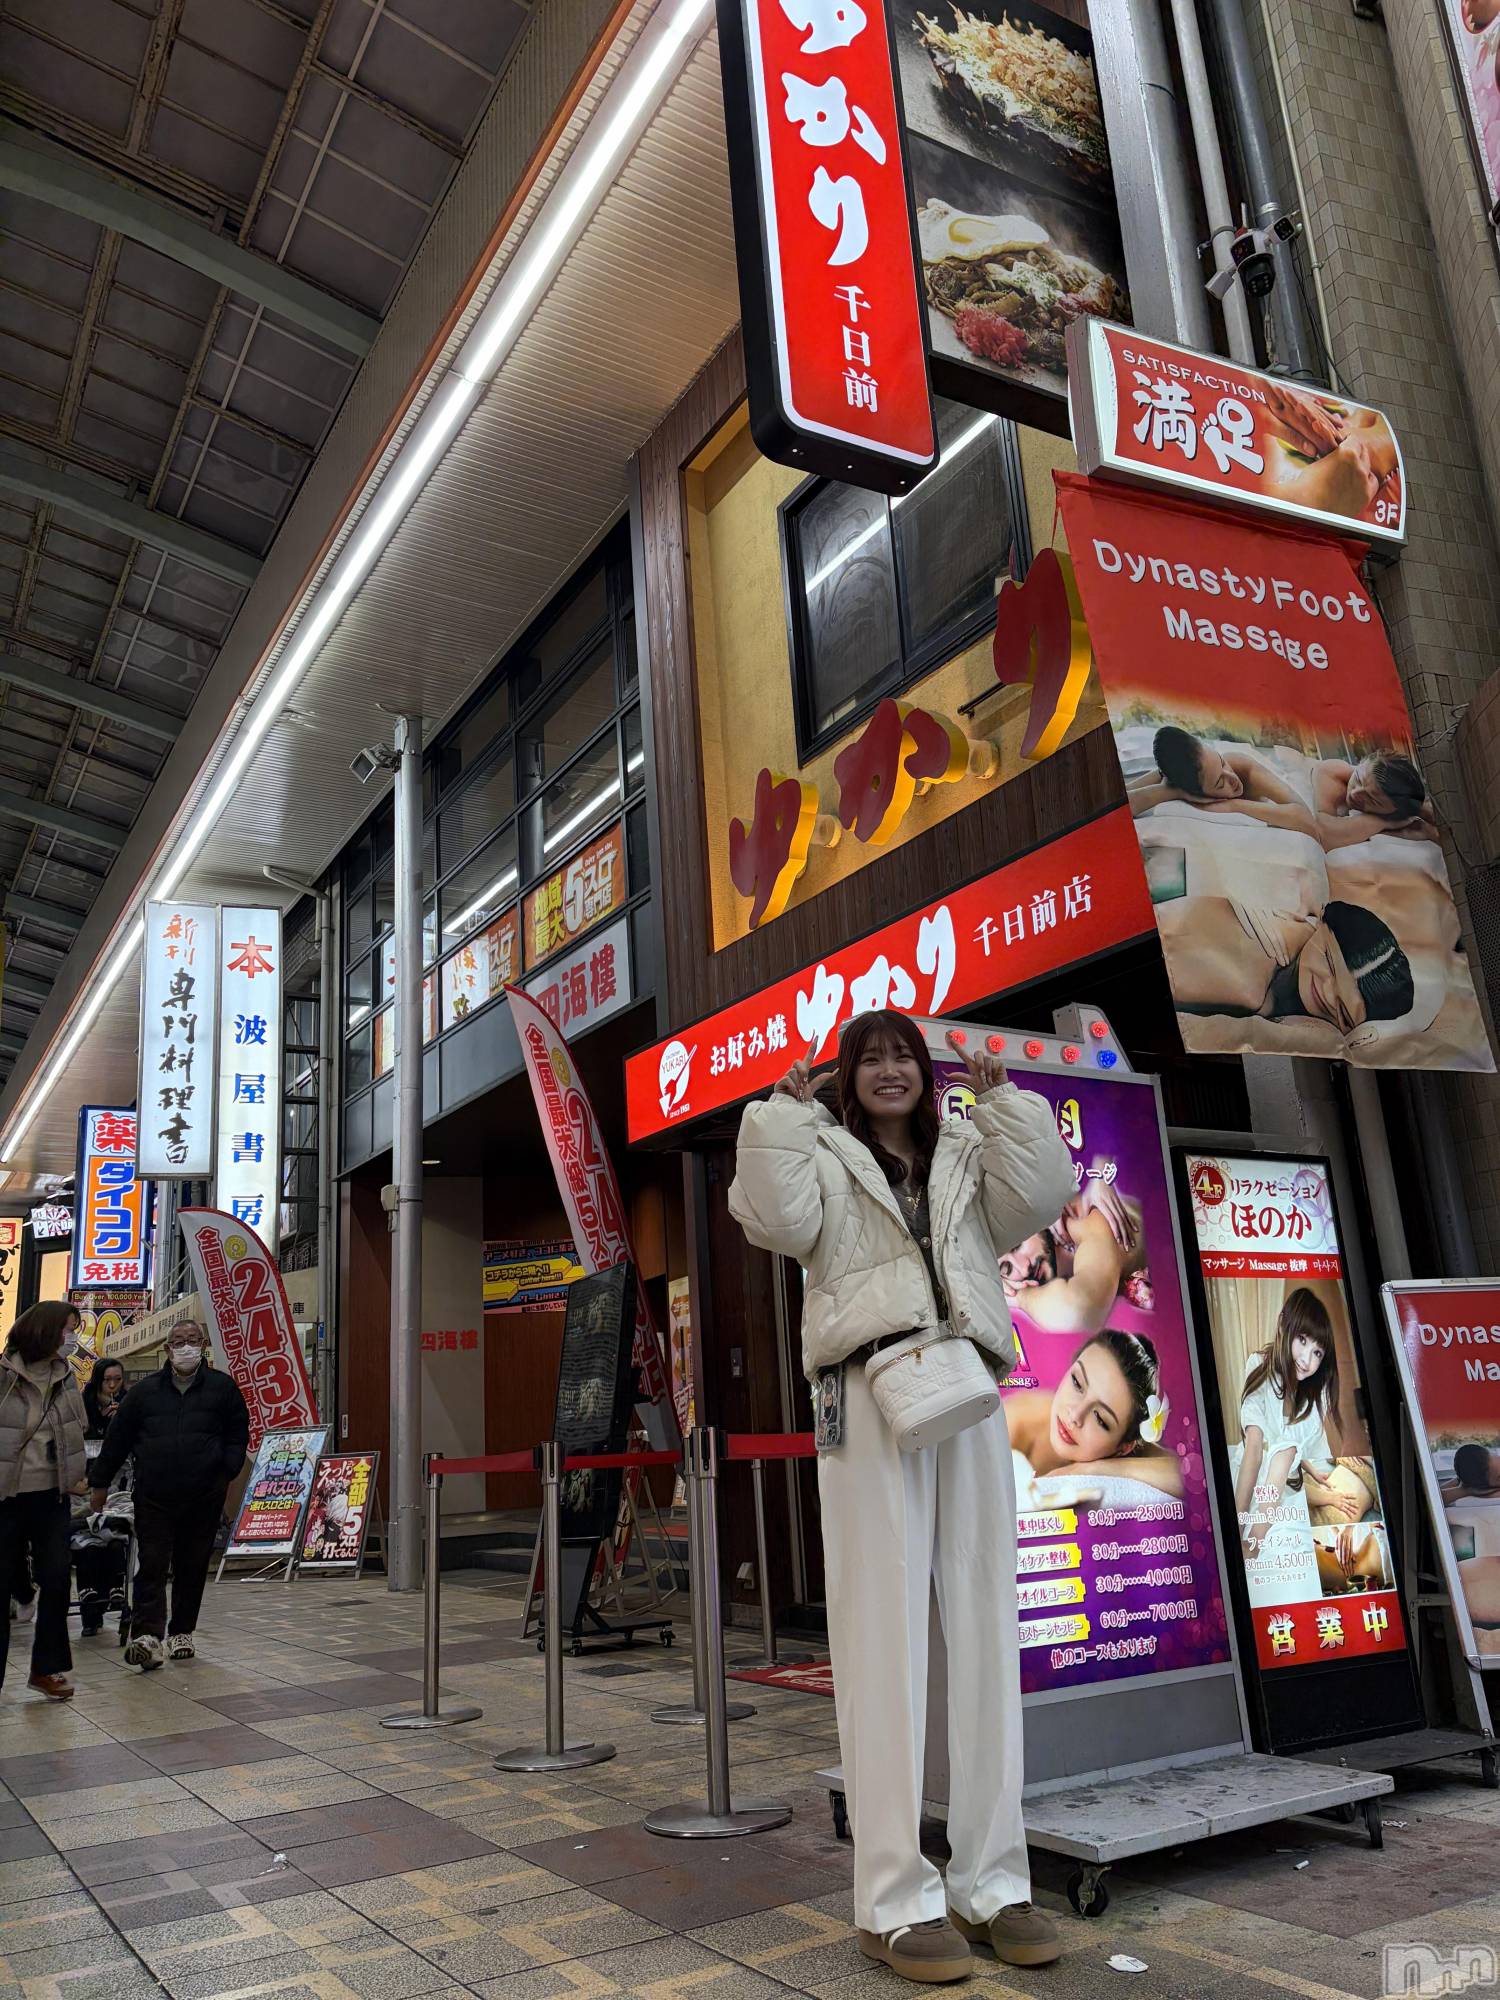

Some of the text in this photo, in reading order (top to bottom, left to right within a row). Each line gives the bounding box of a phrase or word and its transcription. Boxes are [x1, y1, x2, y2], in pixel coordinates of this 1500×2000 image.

[778, 0, 887, 266] ゆかり
[833, 285, 879, 413] 千日前
[1122, 349, 1267, 404] SATISFACTION
[1375, 500, 1399, 525] 3F
[1162, 605, 1329, 670] Massage
[226, 935, 276, 979] 本
[710, 873, 1093, 1077] お好み焼 ゆかり 千日前店
[94, 1111, 135, 1152] 薬
[231, 1013, 269, 1229] 波屋書房
[1195, 1169, 1223, 1199] 4F
[1231, 1178, 1321, 1199] リラクゼーション
[95, 1162, 136, 1255] ダイコク
[1231, 1202, 1313, 1240] ほのか
[83, 1262, 140, 1281] 免税
[1203, 1257, 1245, 1270] マッサージ
[1249, 1259, 1288, 1272] Massage
[1313, 1258, 1339, 1273] 마사지
[421, 1329, 478, 1351] 四海樓
[266, 1451, 307, 1477] 週末
[1247, 1532, 1302, 1551] フェイシャル
[1267, 1601, 1389, 1657] 営業中
[1051, 1636, 1158, 1669] 他のコースもあります
